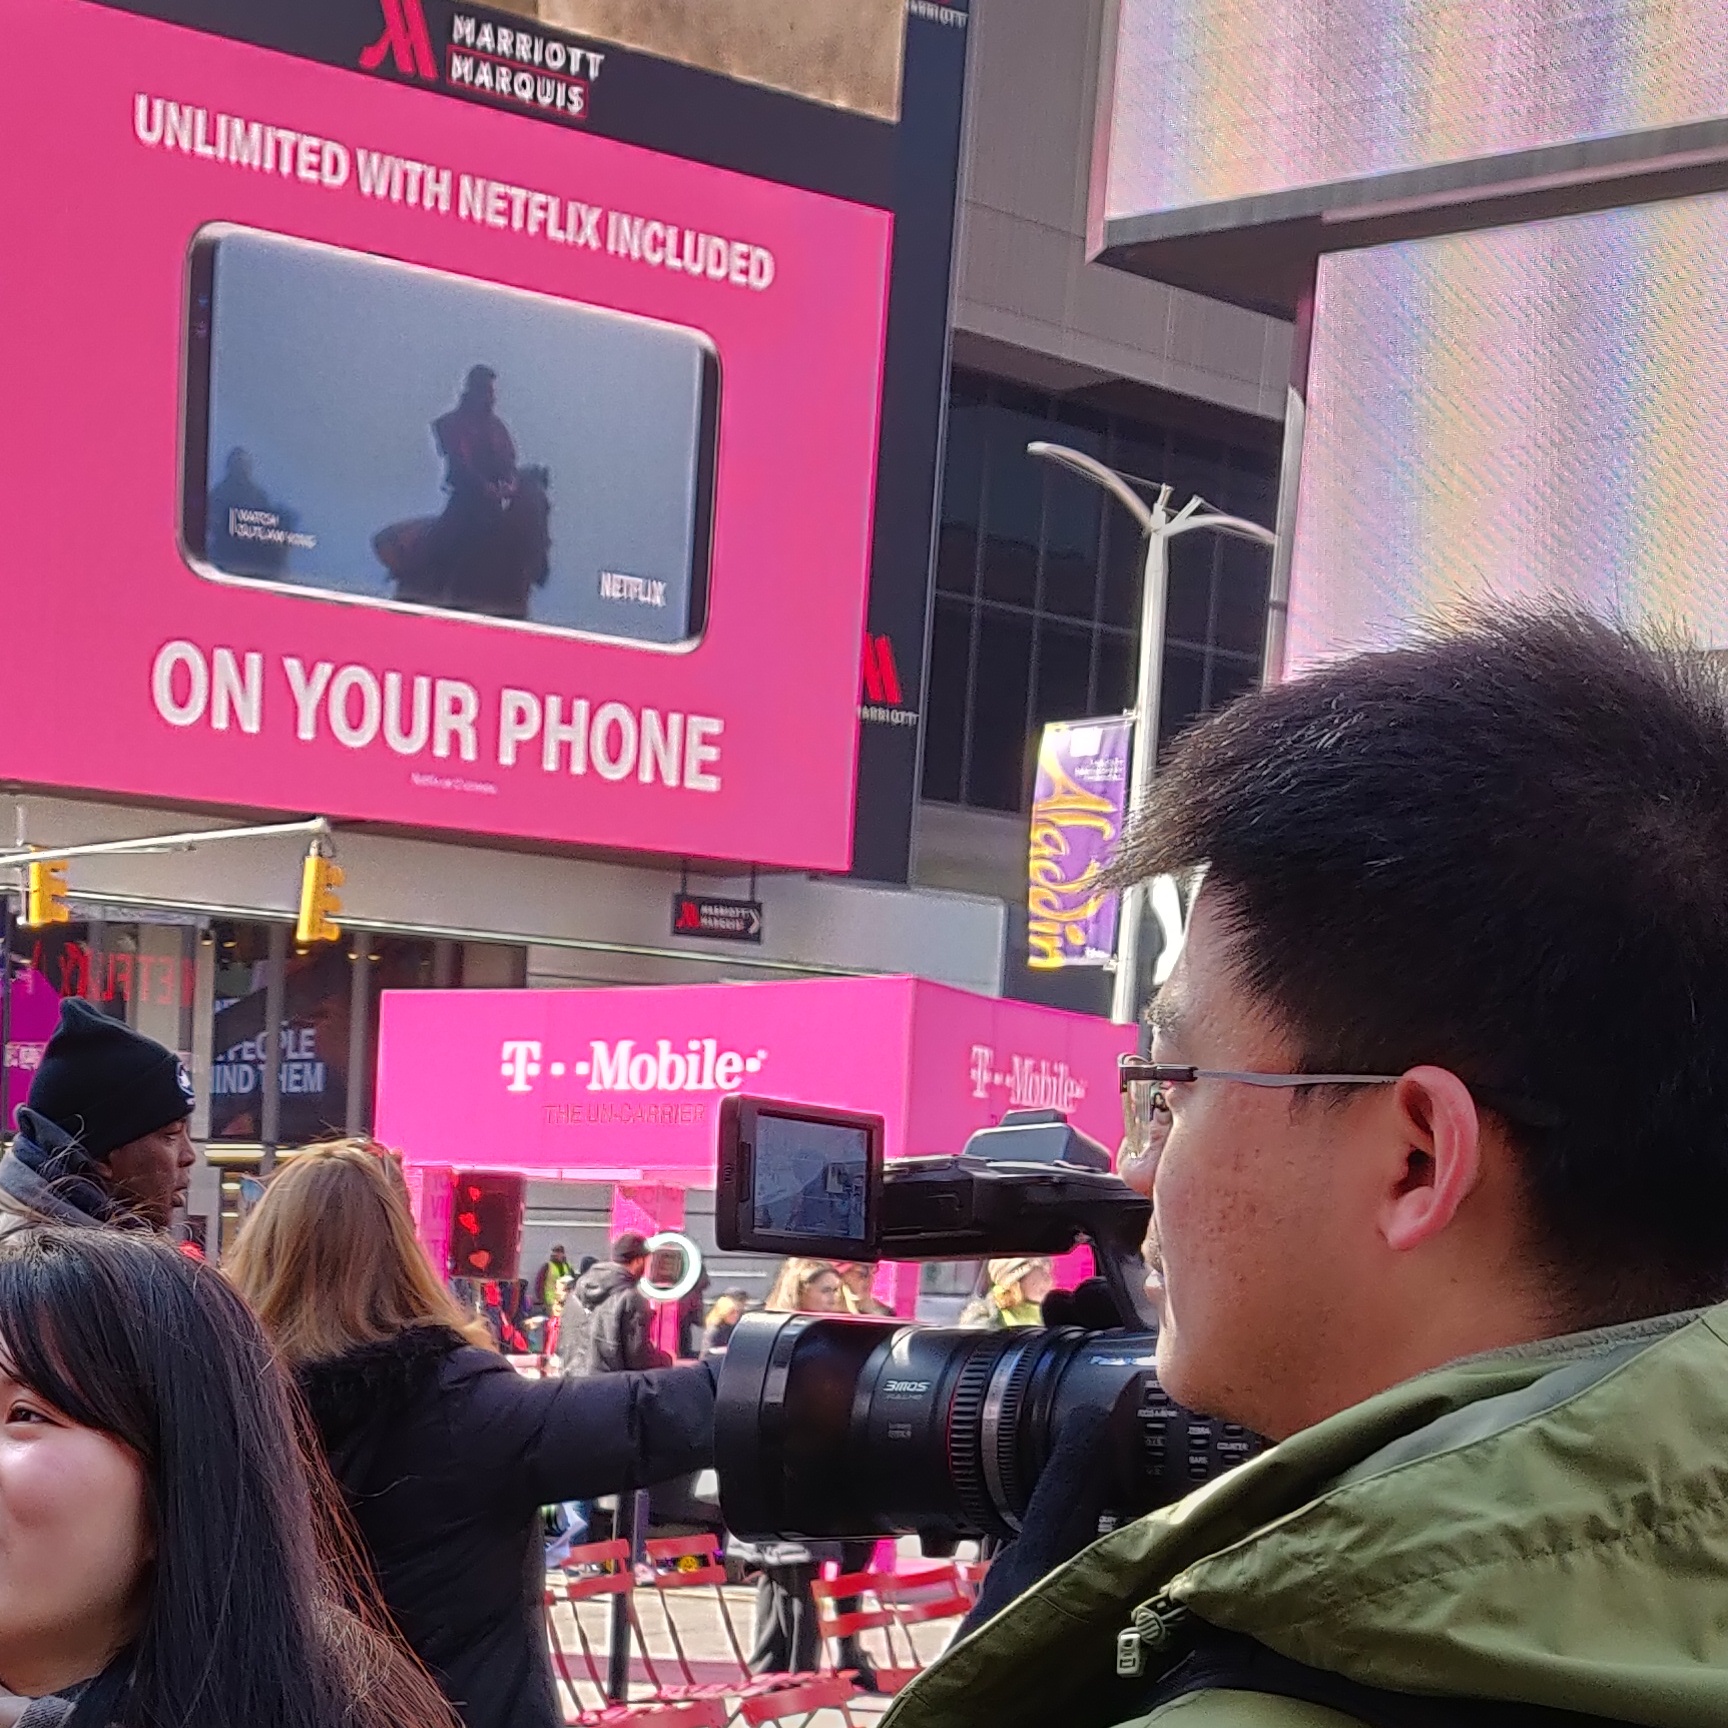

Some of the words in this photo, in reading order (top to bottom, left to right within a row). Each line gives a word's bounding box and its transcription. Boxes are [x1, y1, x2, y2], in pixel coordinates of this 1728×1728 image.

[452, 13, 605, 80] MARRIOTT
[450, 52, 584, 115] MARQUIS
[133, 93, 350, 188] UNLIMITED
[355, 148, 453, 214] WITH
[459, 173, 602, 250] NETFLIX
[606, 209, 775, 292] INCLUDED
[599, 570, 668, 608] NETFLIX
[151, 639, 264, 735] ON
[282, 655, 481, 763] YOUR
[498, 687, 726, 793] PHONE
[258, 1061, 325, 1094] HEM
[544, 1104, 581, 1124] THE
[588, 1103, 707, 1124] UN-CARRIER
